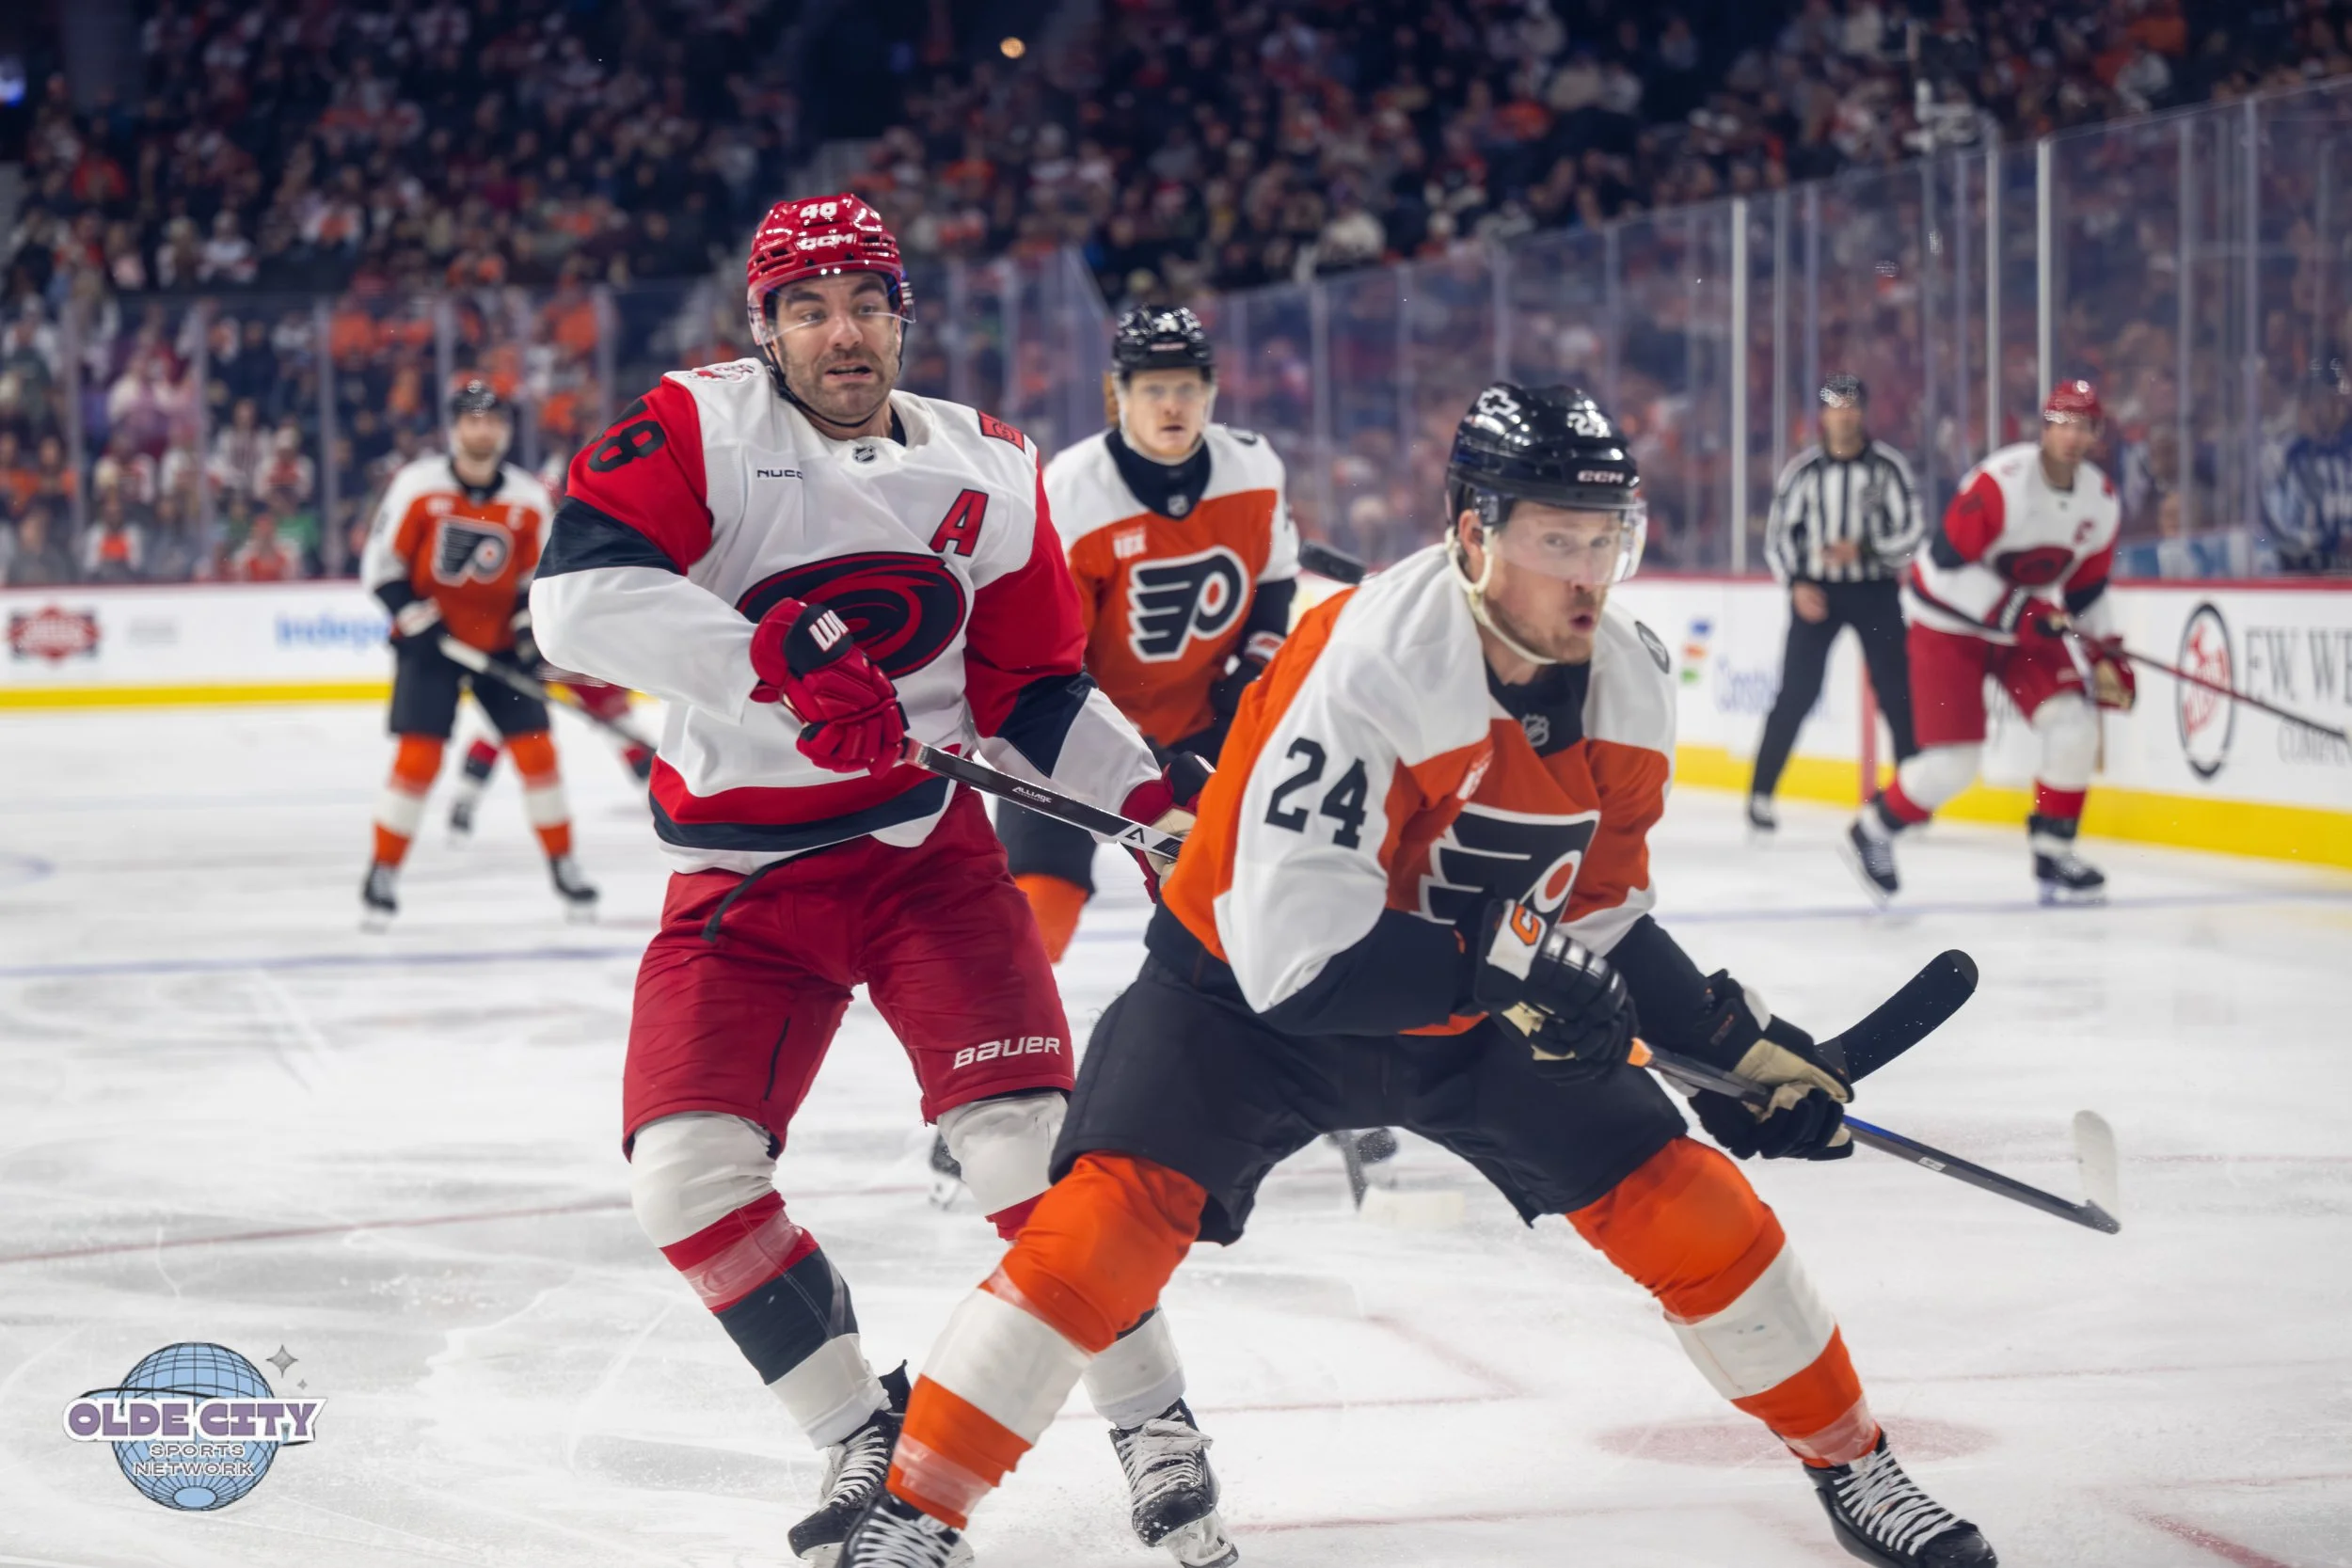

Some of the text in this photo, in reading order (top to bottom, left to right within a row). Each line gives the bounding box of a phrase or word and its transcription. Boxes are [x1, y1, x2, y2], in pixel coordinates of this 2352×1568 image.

[1577, 470, 1625, 484] CCM
[929, 488, 989, 557] A
[1264, 736, 1368, 850] 24
[952, 1036, 1061, 1069] BAUER
